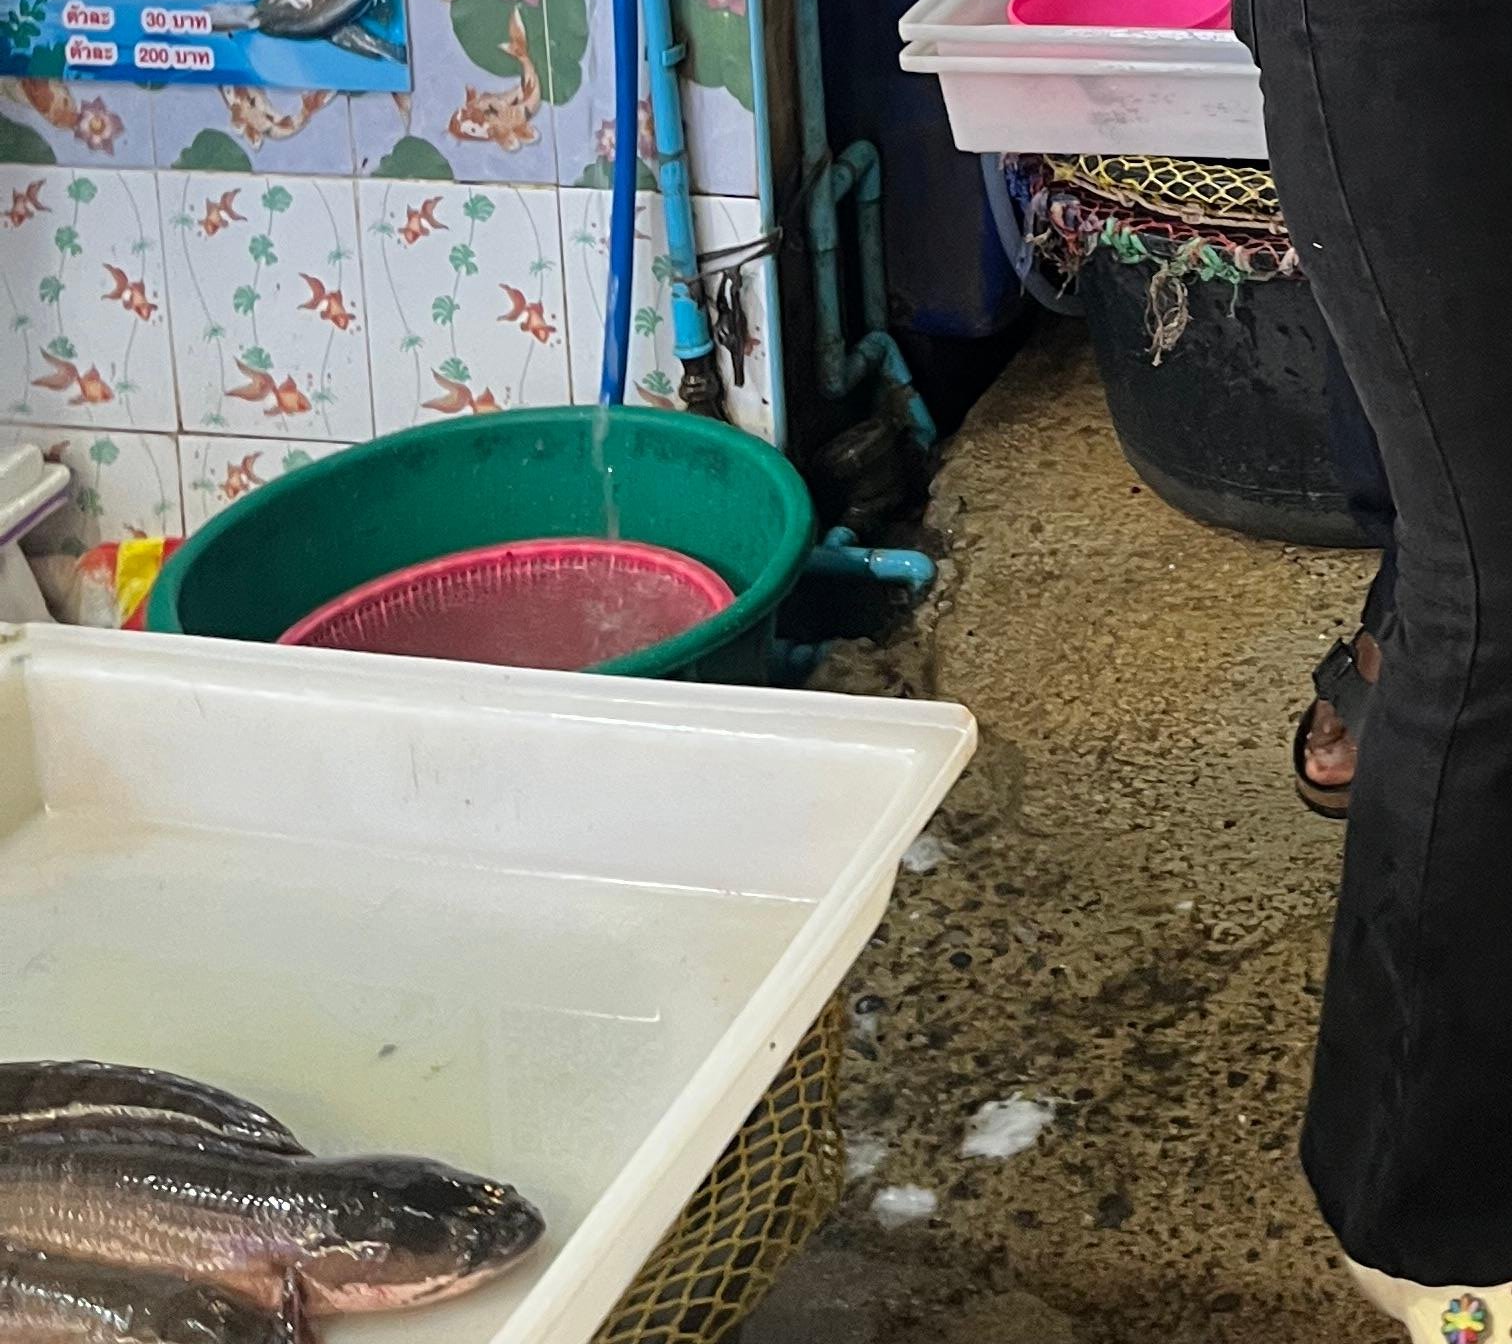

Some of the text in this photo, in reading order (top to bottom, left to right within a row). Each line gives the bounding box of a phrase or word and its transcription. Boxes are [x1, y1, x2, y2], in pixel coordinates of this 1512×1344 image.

[67, 5, 207, 29] ตัวละ 30 บาท
[70, 40, 210, 65] ตัวละ 200 บาท
